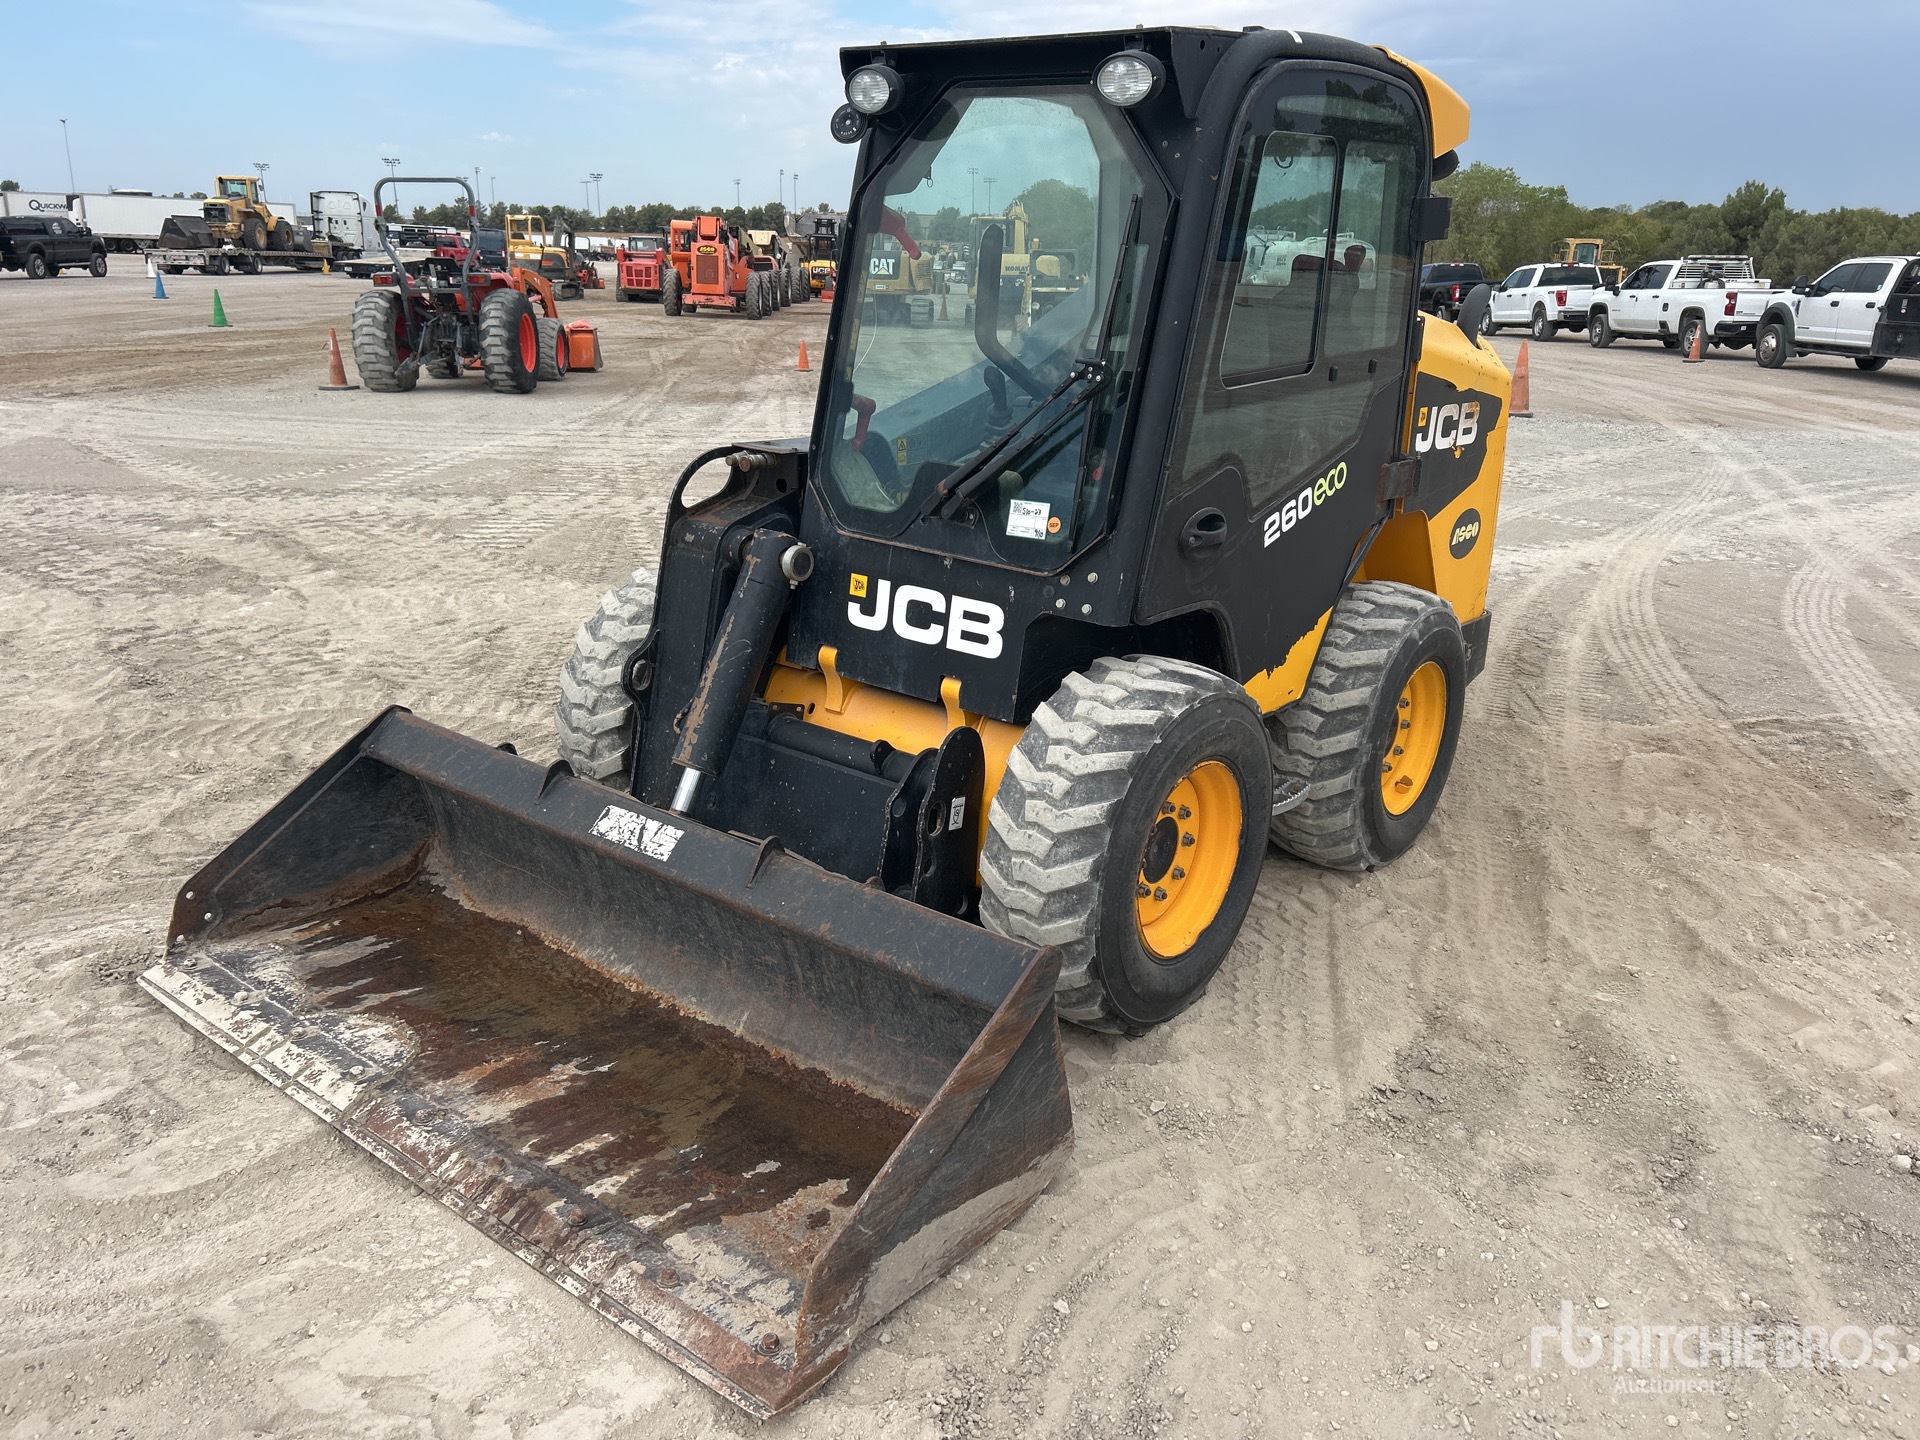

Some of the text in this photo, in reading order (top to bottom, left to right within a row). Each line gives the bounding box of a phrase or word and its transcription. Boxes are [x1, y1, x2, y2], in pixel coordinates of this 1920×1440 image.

[869, 257, 895, 275] CAT
[1415, 401, 1481, 453] JCB
[1451, 521, 1479, 546] ASCO
[847, 578, 1005, 659] JCB
